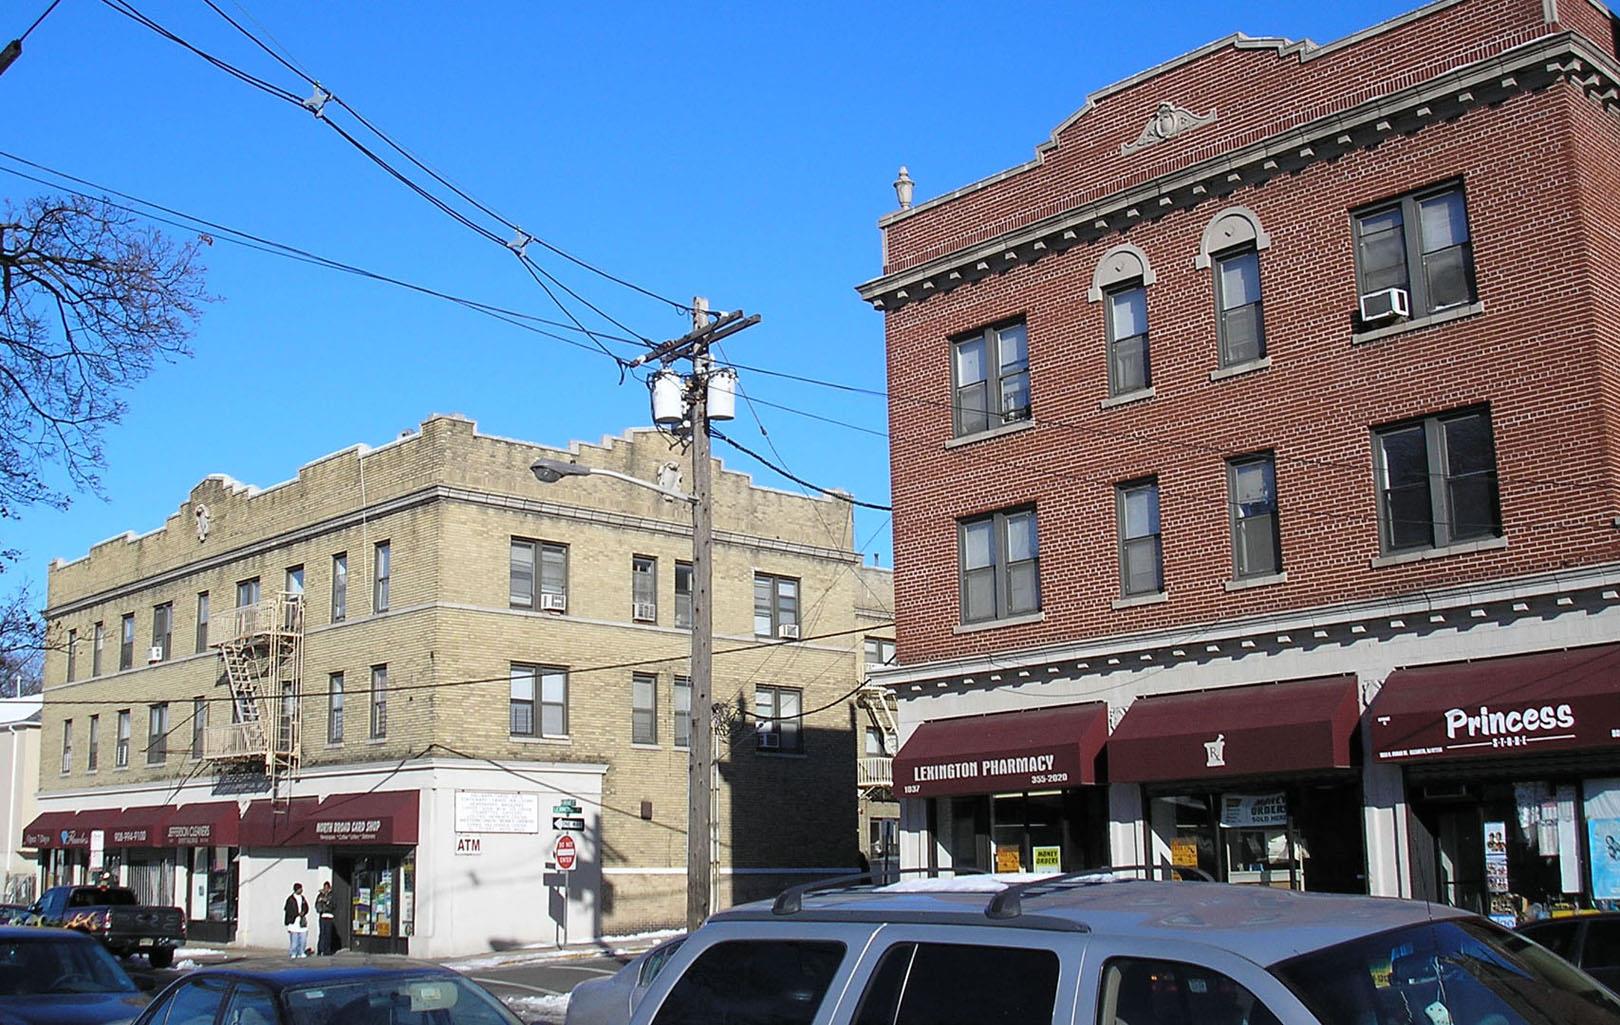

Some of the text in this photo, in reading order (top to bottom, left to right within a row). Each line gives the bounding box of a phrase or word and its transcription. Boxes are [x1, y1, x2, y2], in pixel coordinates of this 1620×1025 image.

[1444, 704, 1575, 738] Princess
[914, 755, 1054, 782] LEXINGTON PHARMACY
[1031, 773, 1068, 784] 355-2020
[904, 785, 920, 794] 1037
[351, 821, 366, 832] CARD
[365, 820, 381, 832] SHOP
[457, 839, 480, 851] ATM
